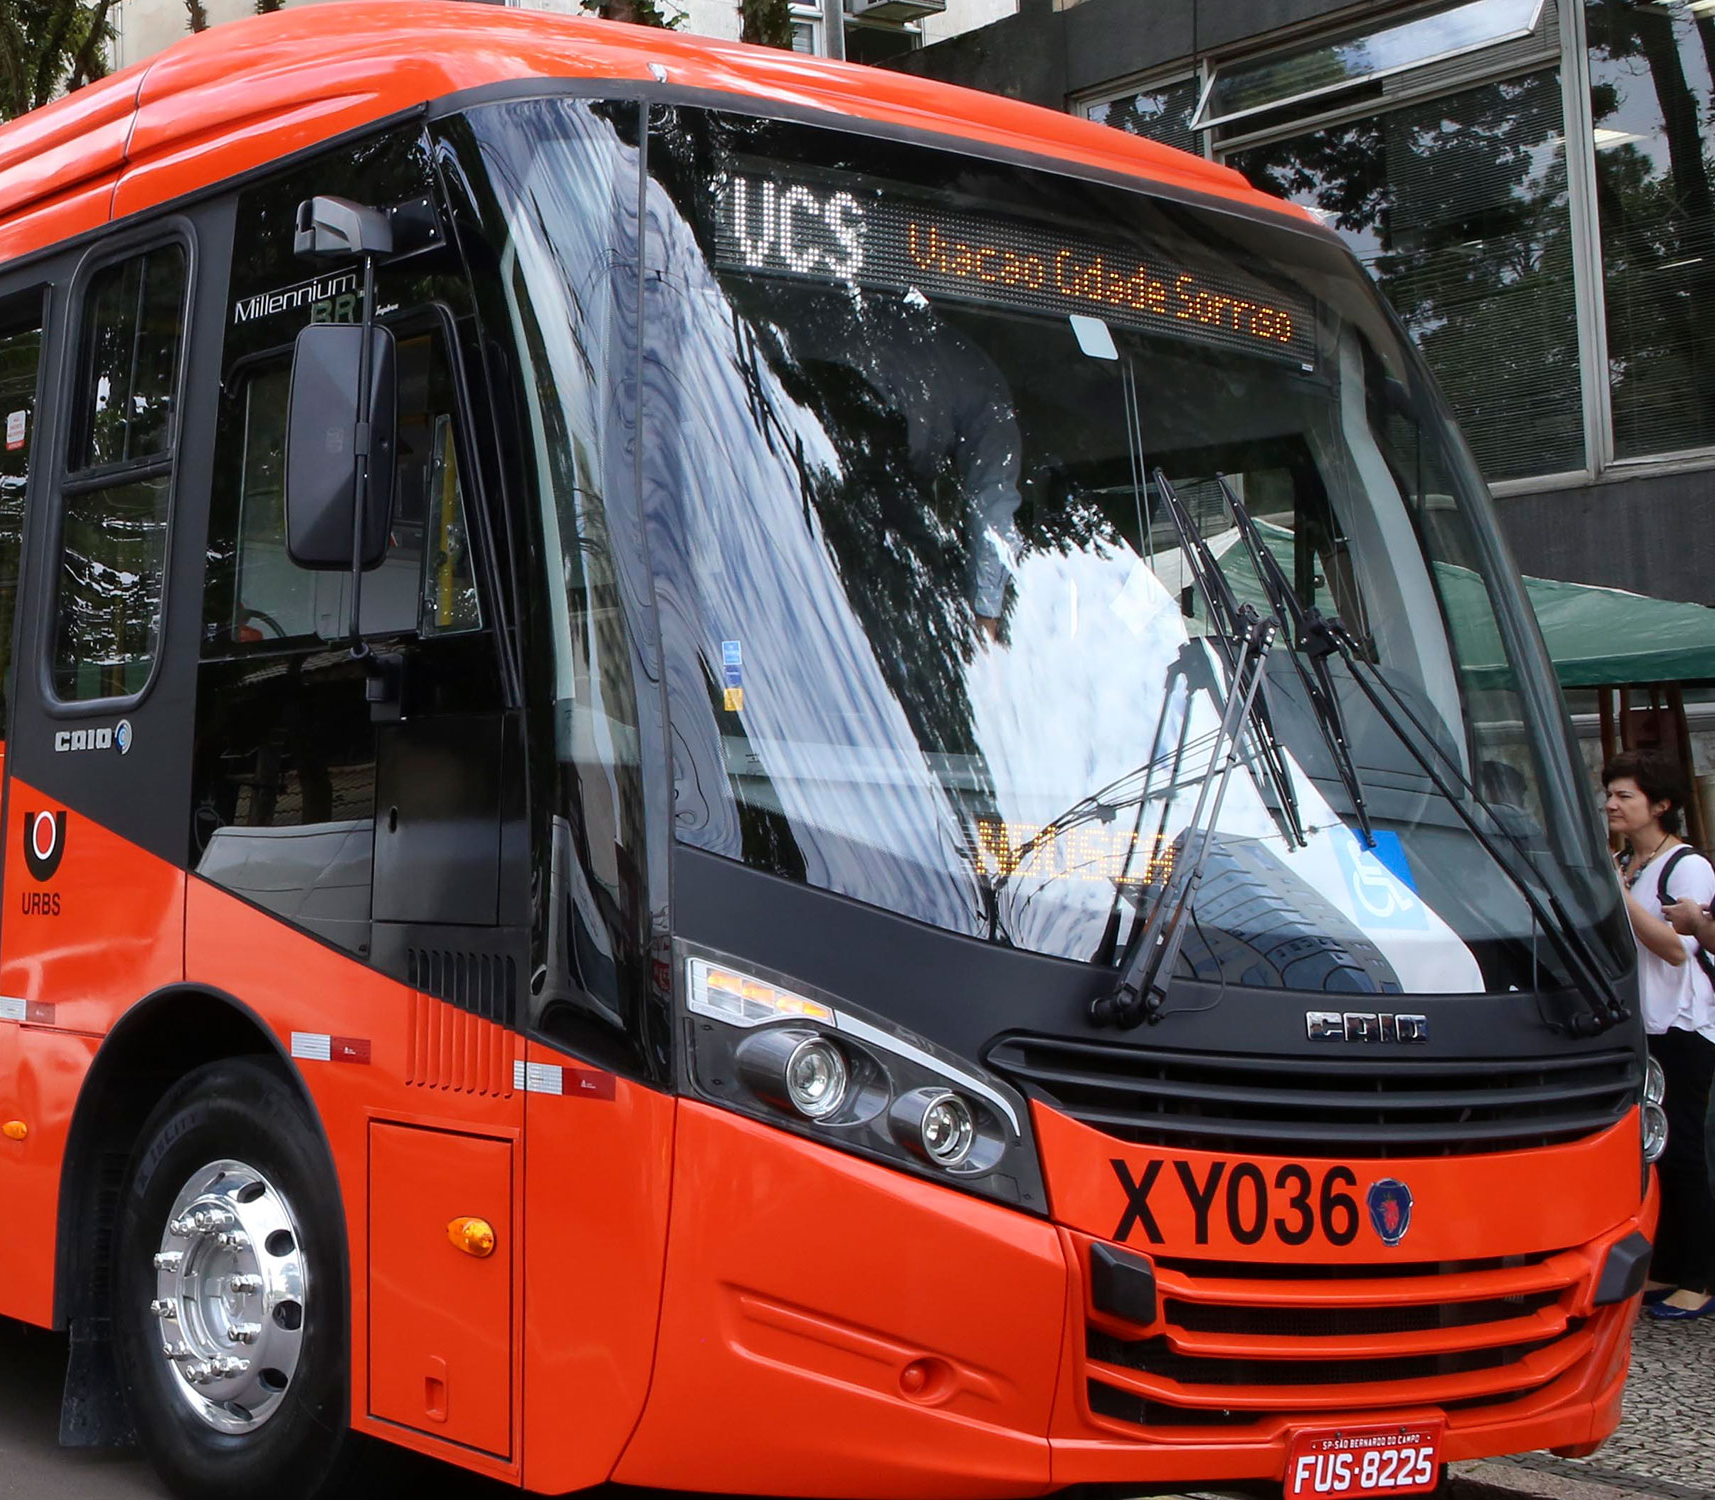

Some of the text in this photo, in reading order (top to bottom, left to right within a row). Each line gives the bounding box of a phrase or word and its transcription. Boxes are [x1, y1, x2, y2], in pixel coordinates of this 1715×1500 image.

[734, 177, 864, 279] UCS
[234, 273, 357, 324] Millennium
[1055, 250, 1166, 314] Cidade
[1175, 274, 1292, 342] Sorriso
[54, 728, 112, 752] CAIO
[22, 892, 61, 916] URBS
[1305, 1011, 1430, 1044] CAIO
[1109, 1158, 1360, 1247] XY036
[1350, 1436, 1386, 1449] BERNARDO
[1387, 1436, 1396, 1446] DO
[1398, 1434, 1420, 1445] CAMPO
